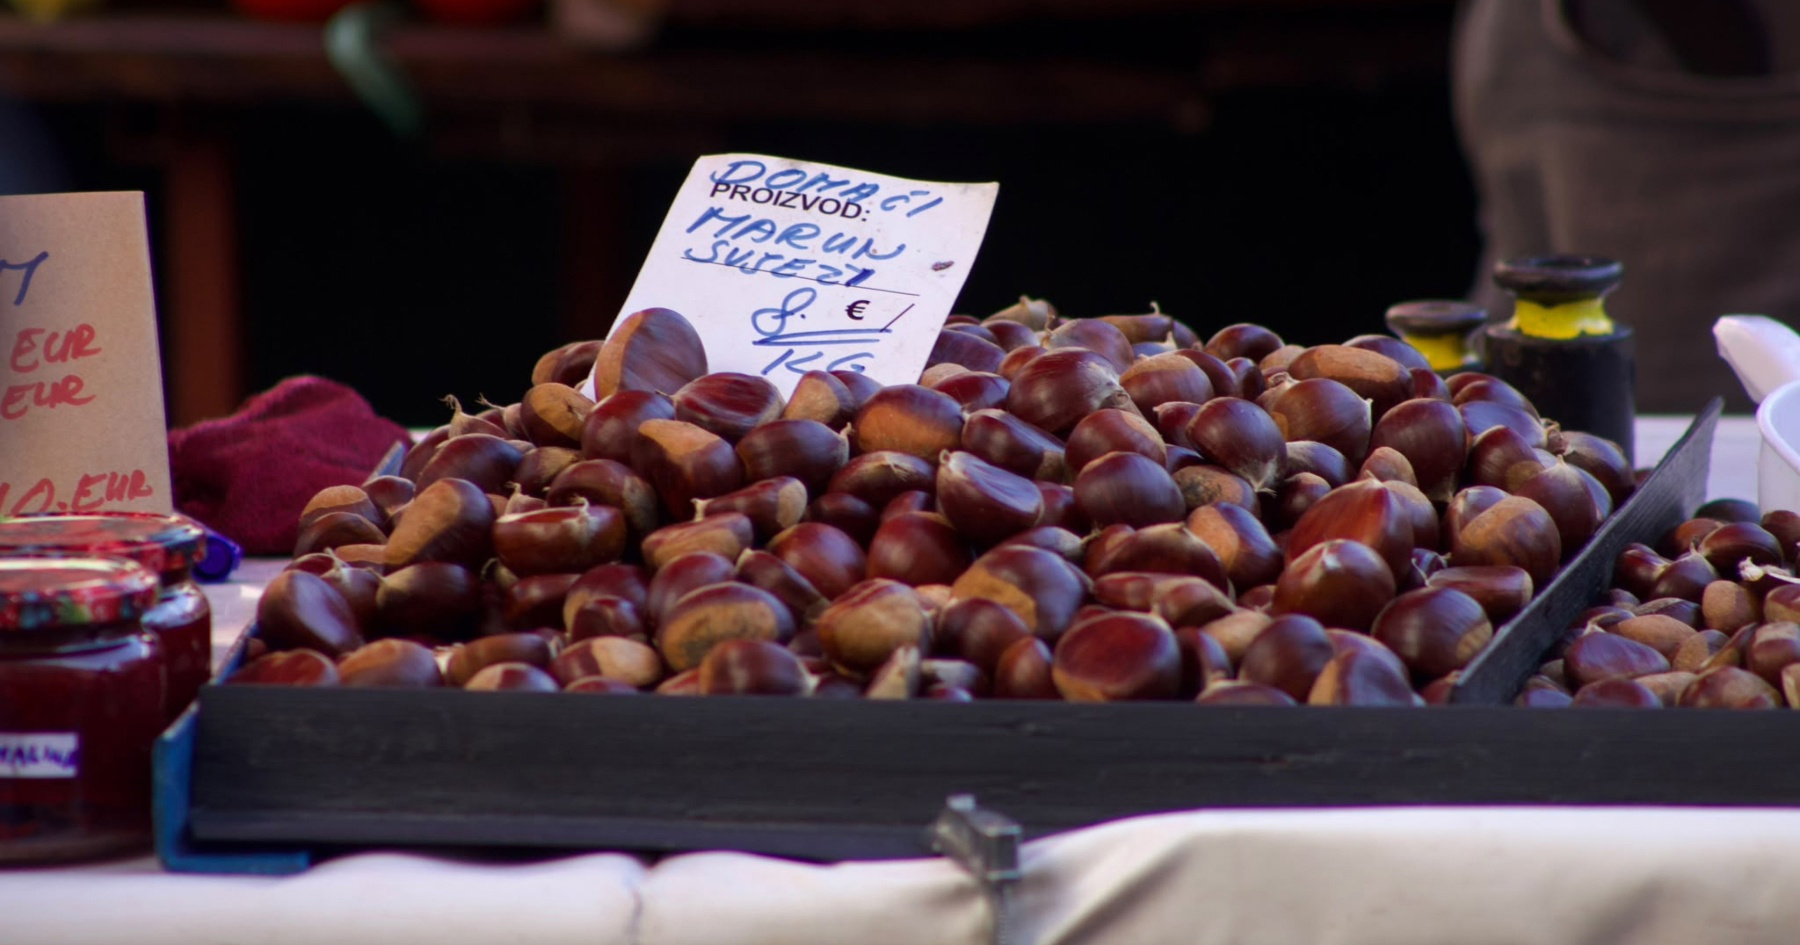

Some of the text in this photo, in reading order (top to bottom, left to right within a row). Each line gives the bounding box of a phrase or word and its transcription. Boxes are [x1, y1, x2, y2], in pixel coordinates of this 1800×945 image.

[709, 182, 871, 222] PROIZVOD:
[686, 206, 906, 260] MARUN
[10, 324, 102, 373] EUR
[1, 375, 96, 420] EUR
